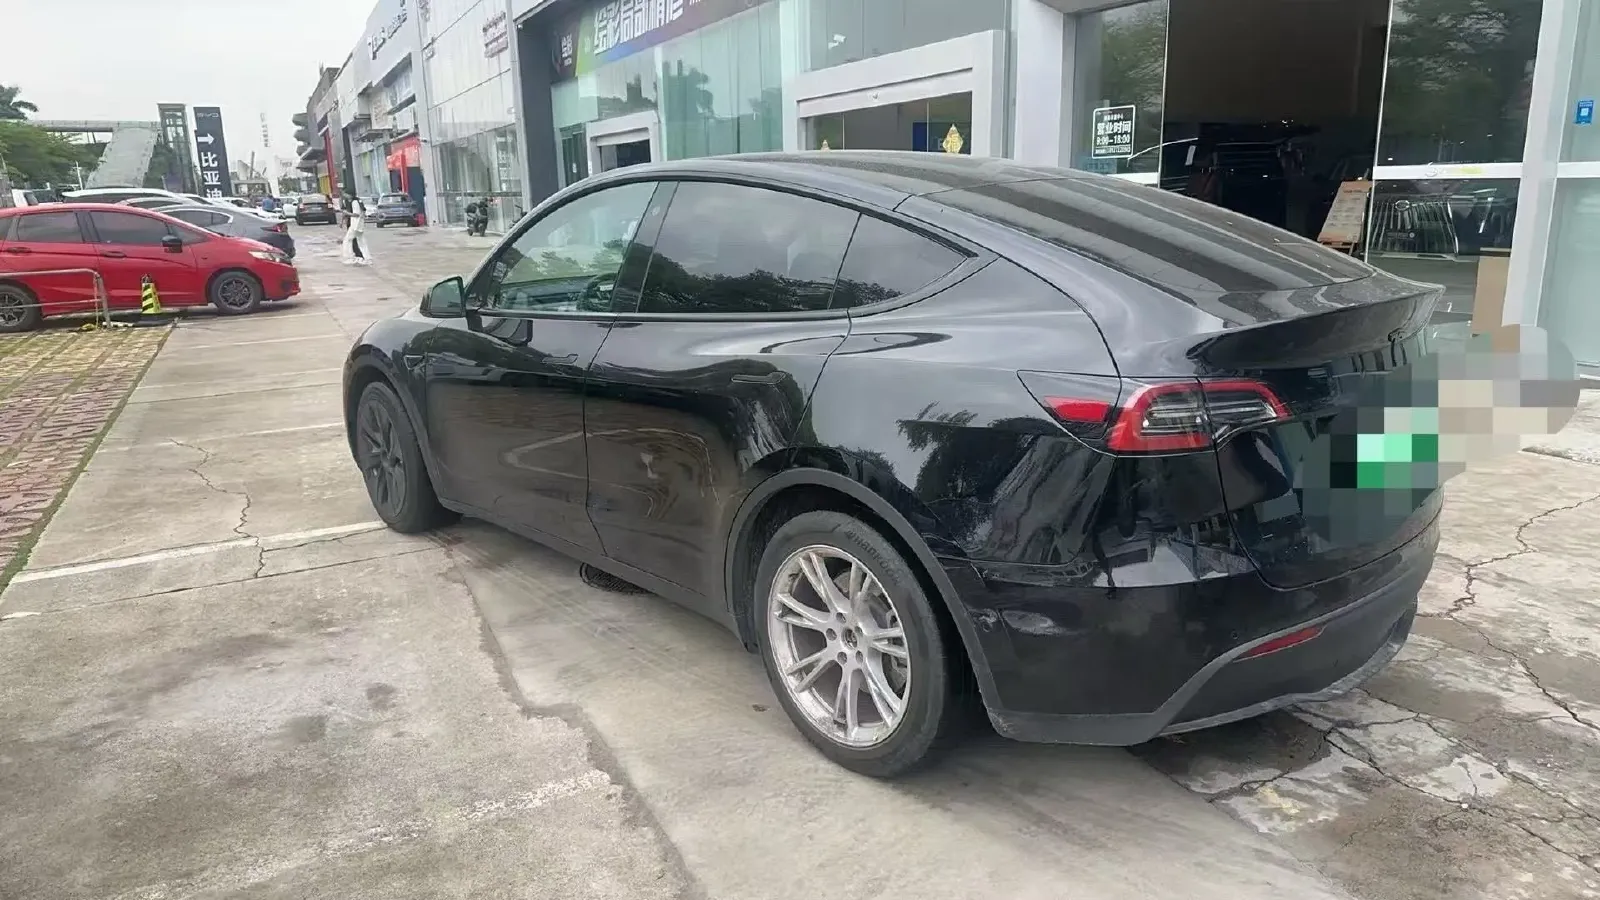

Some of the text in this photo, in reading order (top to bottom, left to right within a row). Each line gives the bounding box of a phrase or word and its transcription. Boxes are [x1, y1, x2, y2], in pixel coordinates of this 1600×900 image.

[1097, 121, 1131, 135] 营业时间
[201, 151, 222, 198] 比亚迪
